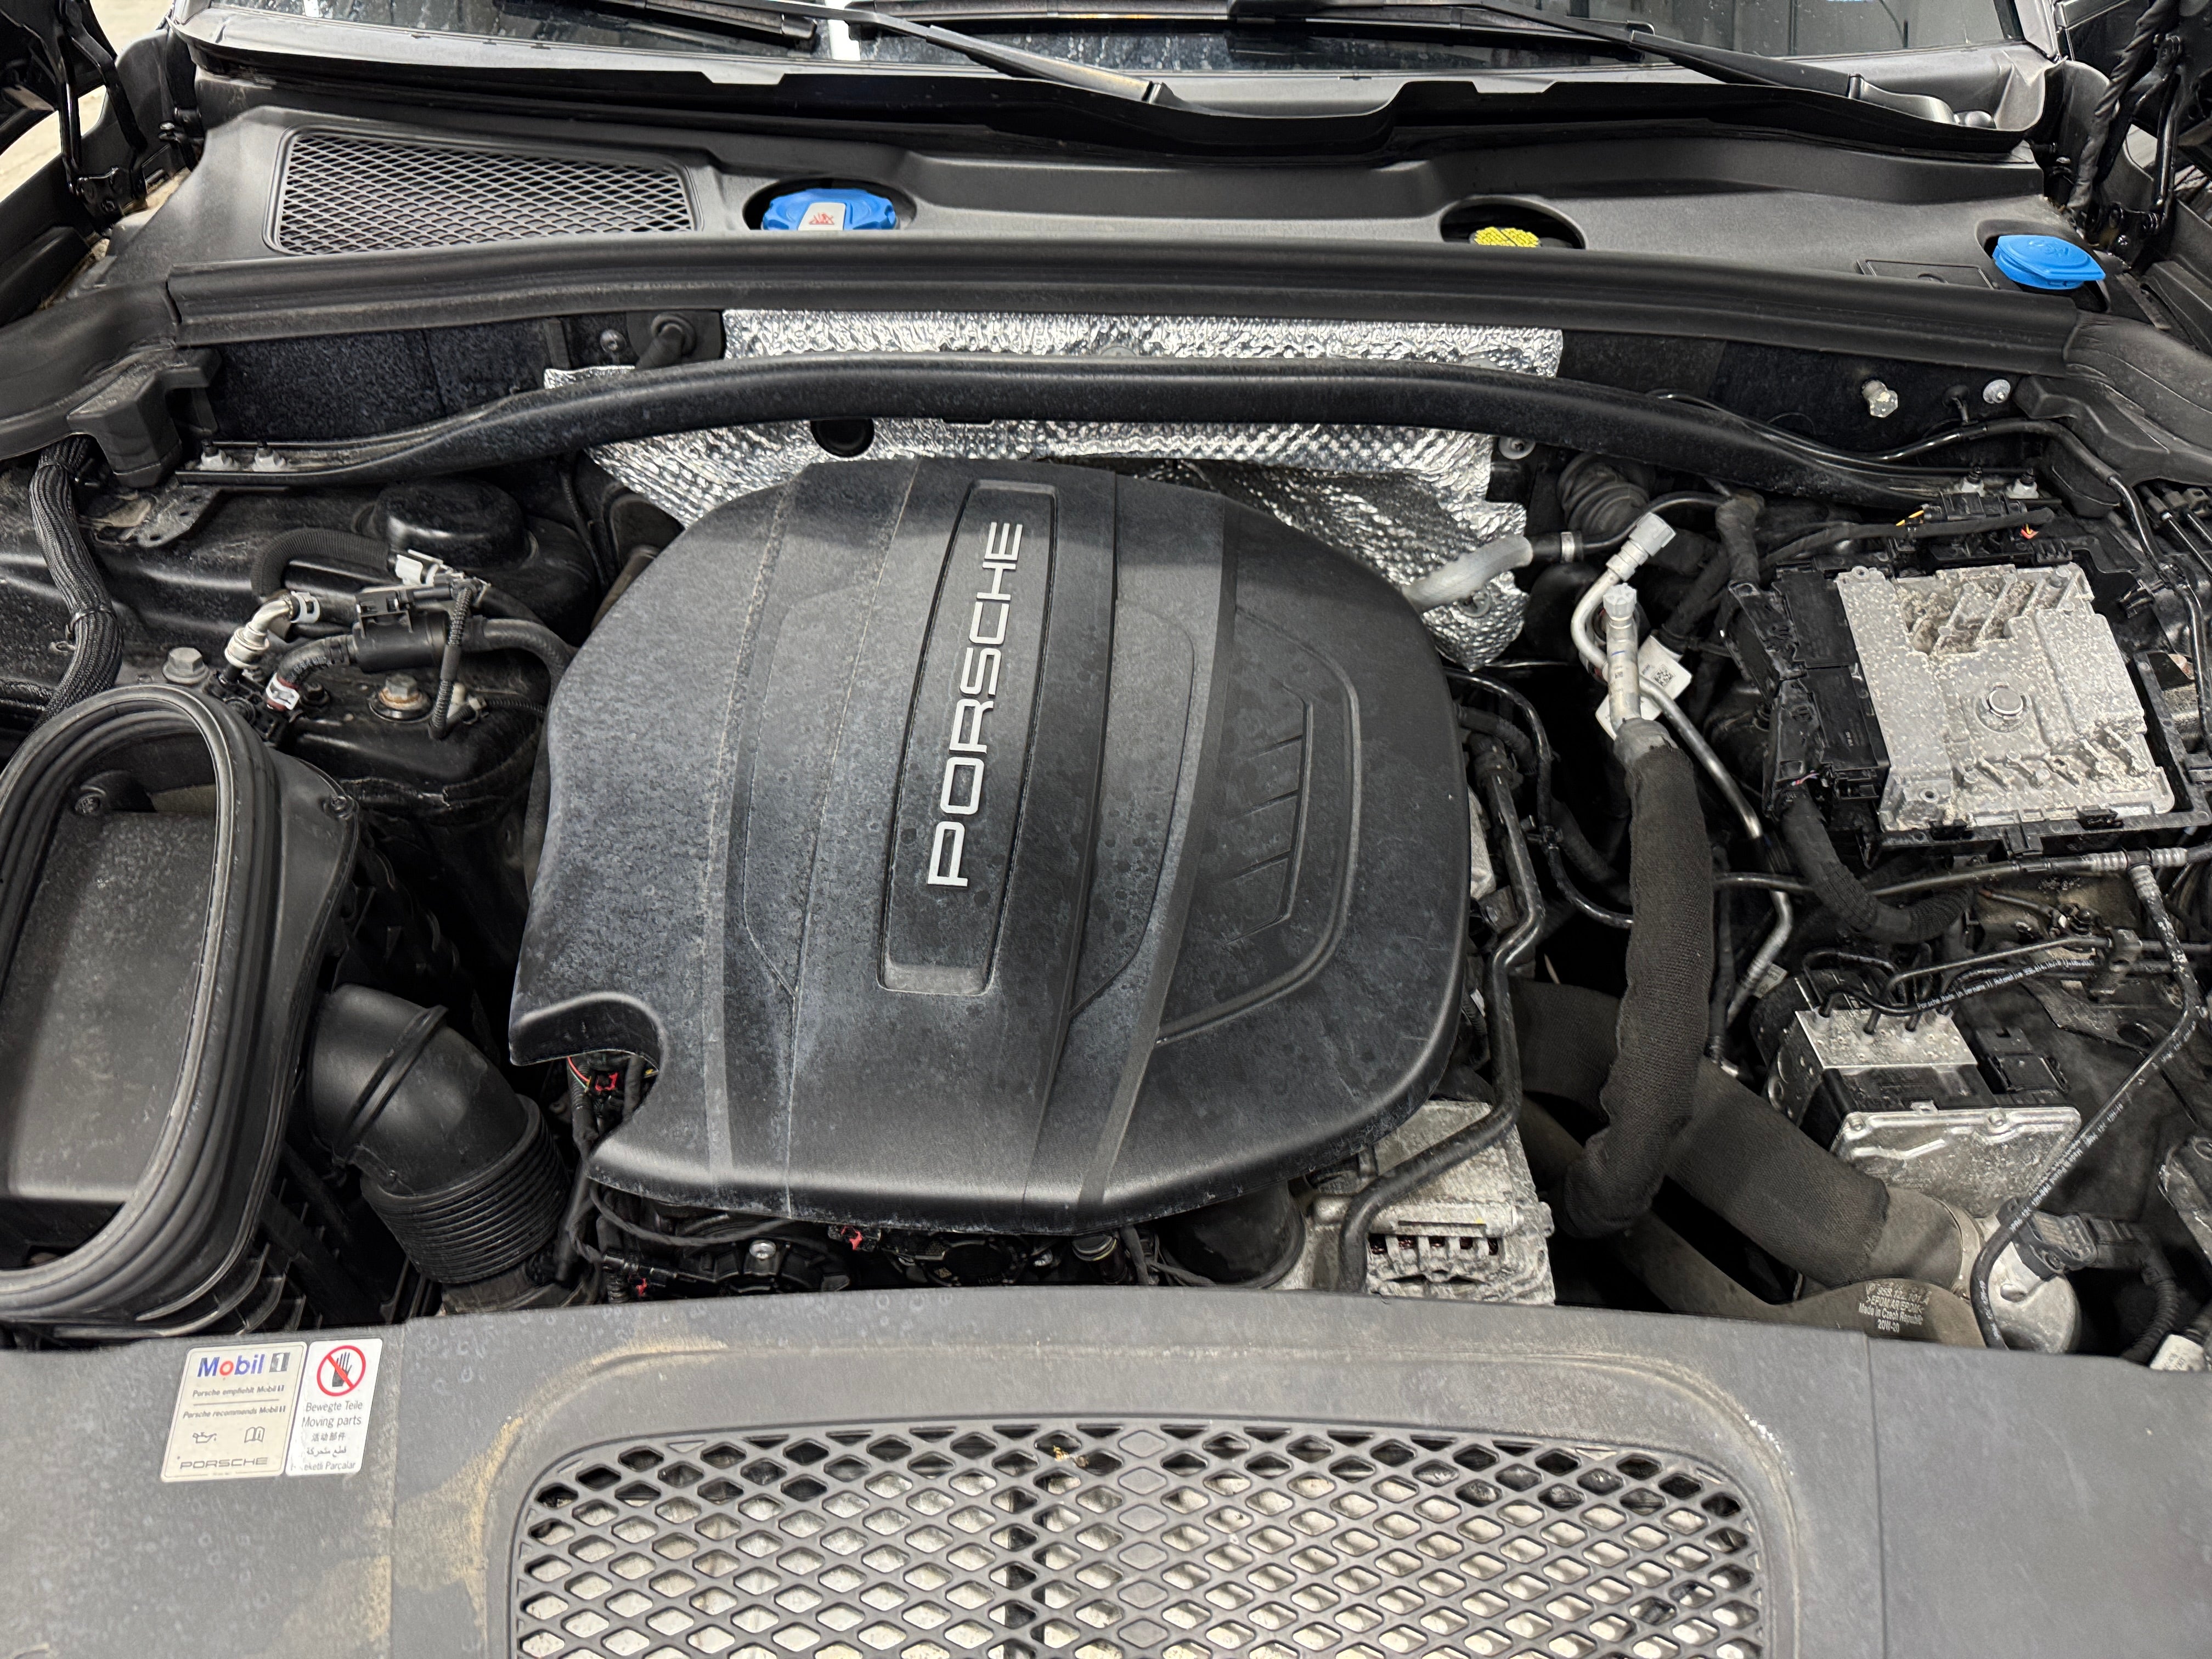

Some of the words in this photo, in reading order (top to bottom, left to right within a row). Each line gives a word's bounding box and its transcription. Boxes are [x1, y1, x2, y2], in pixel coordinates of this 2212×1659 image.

[928, 522, 1022, 886] PORSCHE
[1859, 1302, 1874, 1316] Made
[1882, 1308, 1898, 1321] Czech
[197, 1354, 266, 1378] Mobil
[193, 1389, 220, 1397] Porsche
[222, 1387, 254, 1396] empfiehlt
[306, 1402, 342, 1413] Bewegte
[345, 1400, 363, 1410] Teile
[183, 1410, 211, 1419] Porsche
[212, 1408, 257, 1417] recommends
[302, 1416, 334, 1429] Moving
[336, 1415, 362, 1428] parts
[180, 1457, 268, 1470] PORSCHE
